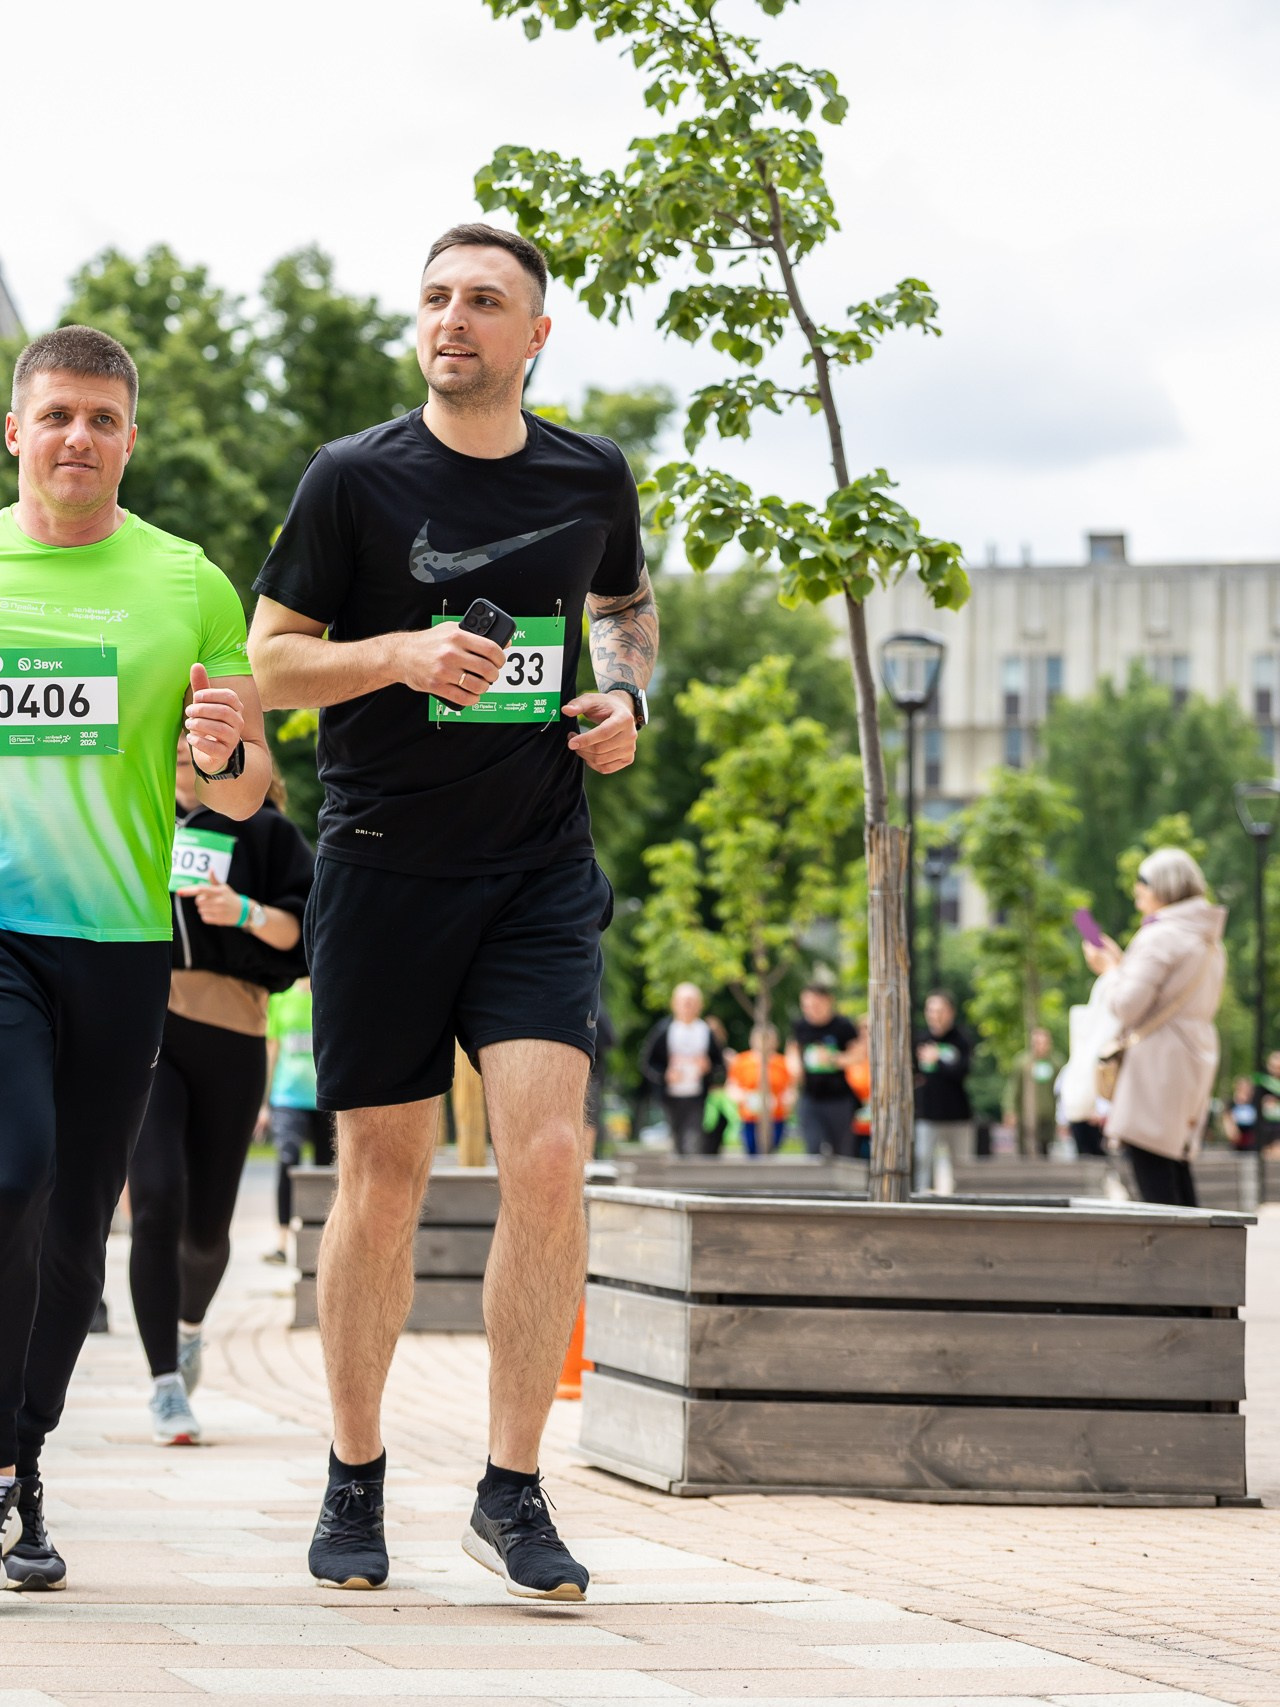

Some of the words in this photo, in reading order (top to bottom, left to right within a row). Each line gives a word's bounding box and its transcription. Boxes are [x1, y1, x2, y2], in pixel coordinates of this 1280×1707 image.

[33, 659, 63, 671] Звук
[506, 652, 544, 686] 33
[355, 828, 384, 838] DRI-FIT
